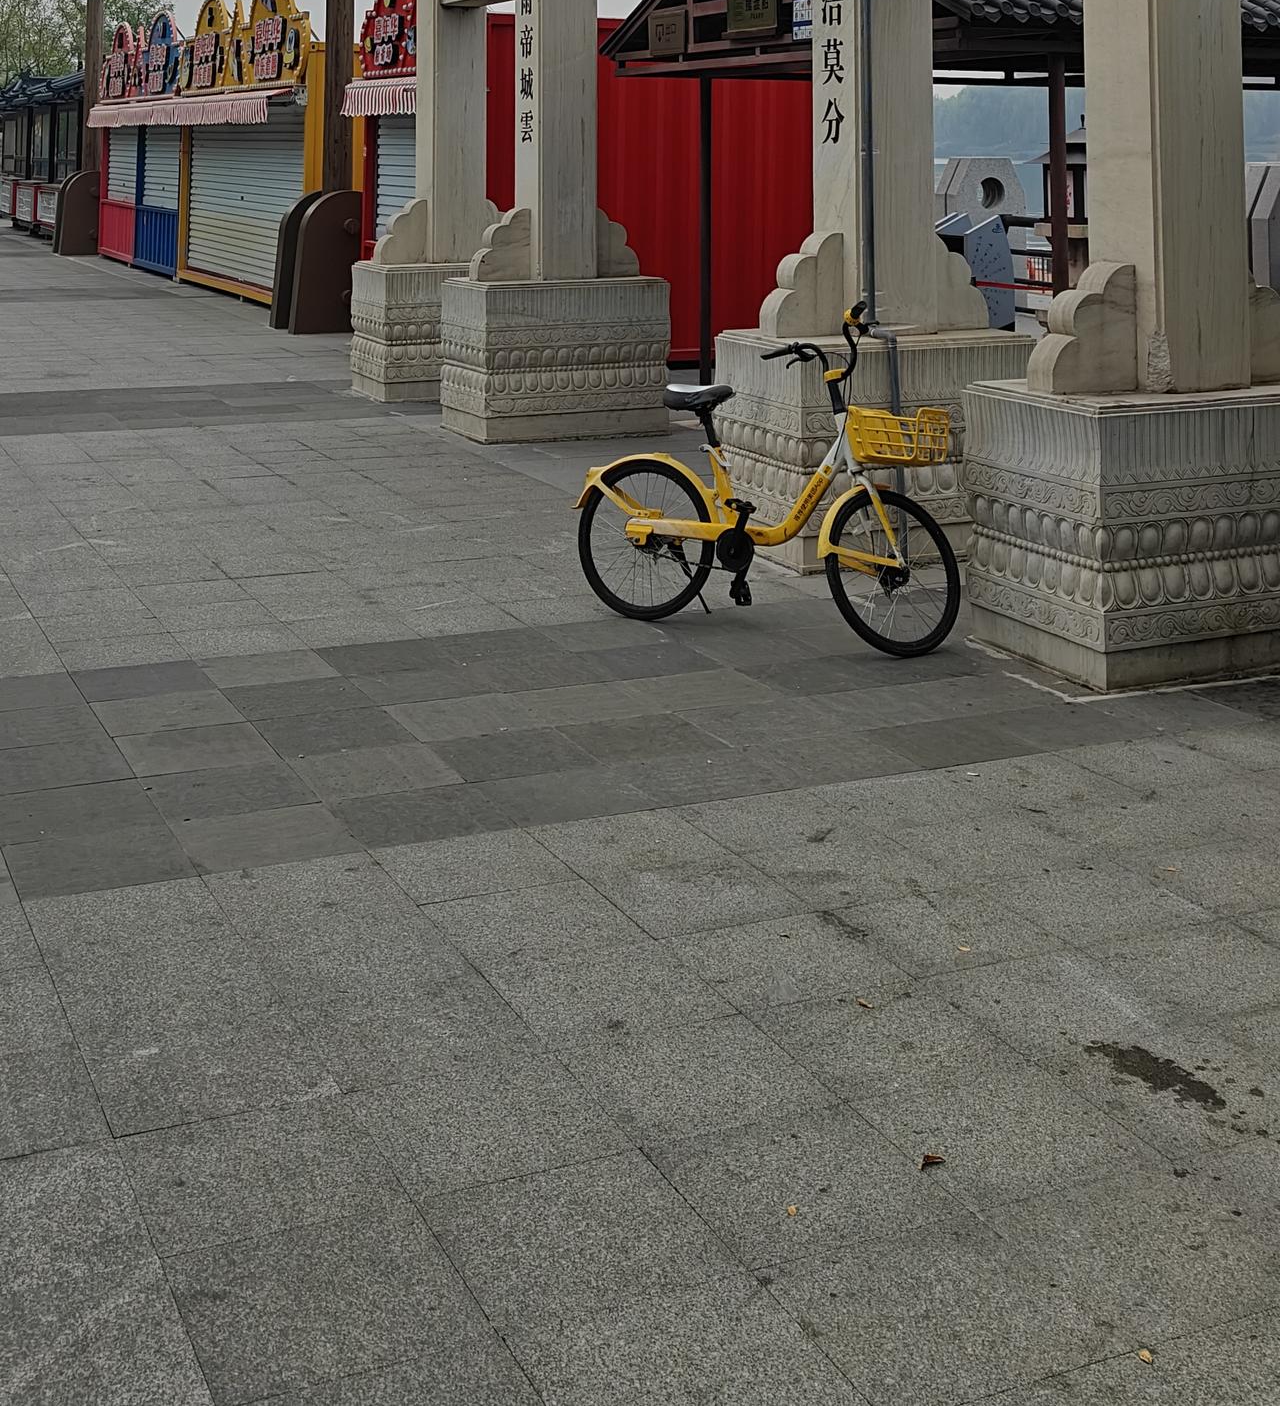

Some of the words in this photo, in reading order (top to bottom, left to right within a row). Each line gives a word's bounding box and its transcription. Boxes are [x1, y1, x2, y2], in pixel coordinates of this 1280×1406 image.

[254, 15, 283, 54] 嘉年华
[374, 14, 399, 43] 嘉年华
